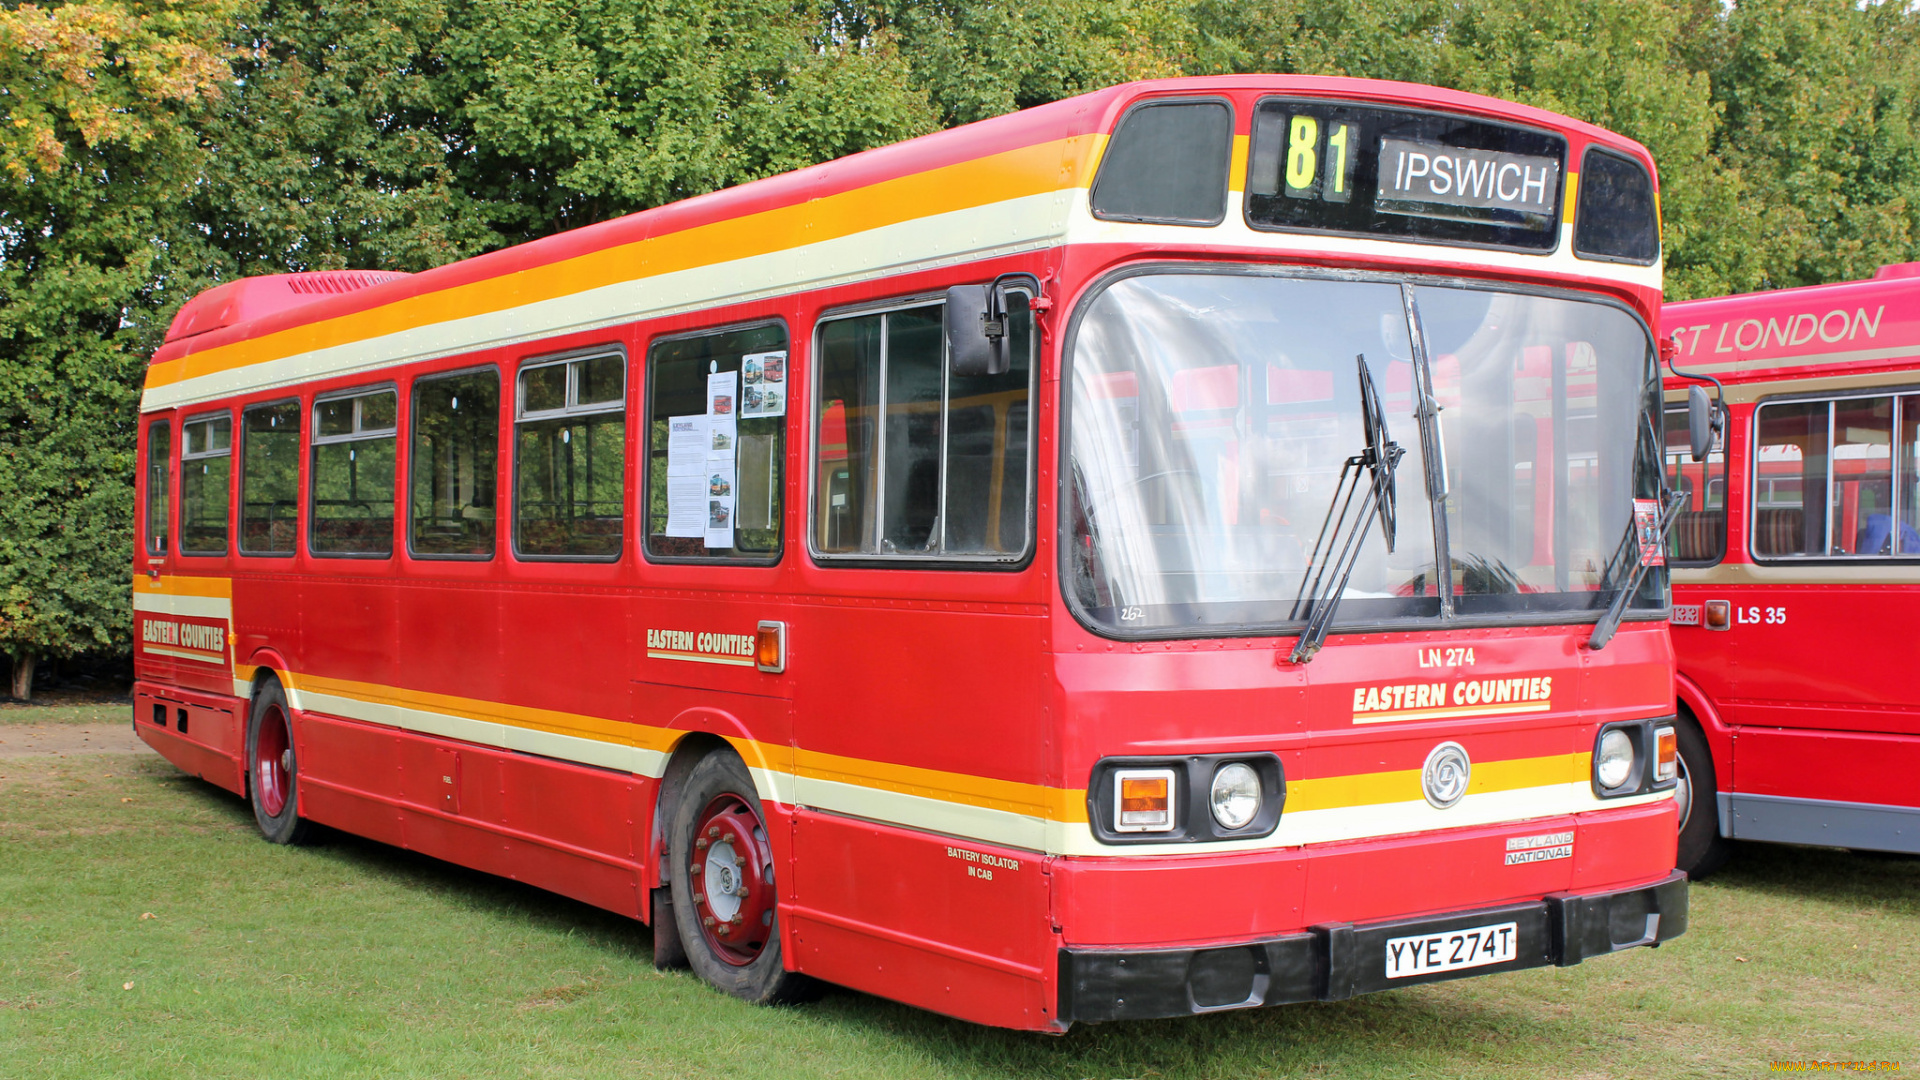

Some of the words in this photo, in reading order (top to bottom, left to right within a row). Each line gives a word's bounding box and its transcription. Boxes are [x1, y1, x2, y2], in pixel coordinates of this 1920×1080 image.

[1285, 115, 1349, 193] 81
[1394, 150, 1547, 205] IPSWICH
[1715, 305, 1885, 353] LONDON
[1121, 606, 1146, 620] 262
[1738, 607, 1761, 624] LS
[1765, 607, 1786, 624] 35
[181, 623, 225, 652] COUNTIES
[647, 628, 695, 651] EASTERN
[697, 632, 756, 656] COUNTIES
[1418, 648, 1442, 668] LN
[1446, 647, 1476, 667] 274
[1352, 682, 1447, 712] EASTERN
[1452, 676, 1552, 705] COUNTIES
[1507, 832, 1573, 850] LEYLAND
[947, 847, 980, 863] BATTERY
[981, 853, 1019, 871] ISOLATOR
[1505, 847, 1571, 865] NATIONAL
[967, 865, 976, 877] IN
[976, 868, 993, 881] CAB
[1390, 938, 1443, 971] YYE
[1449, 927, 1513, 965] 274T
